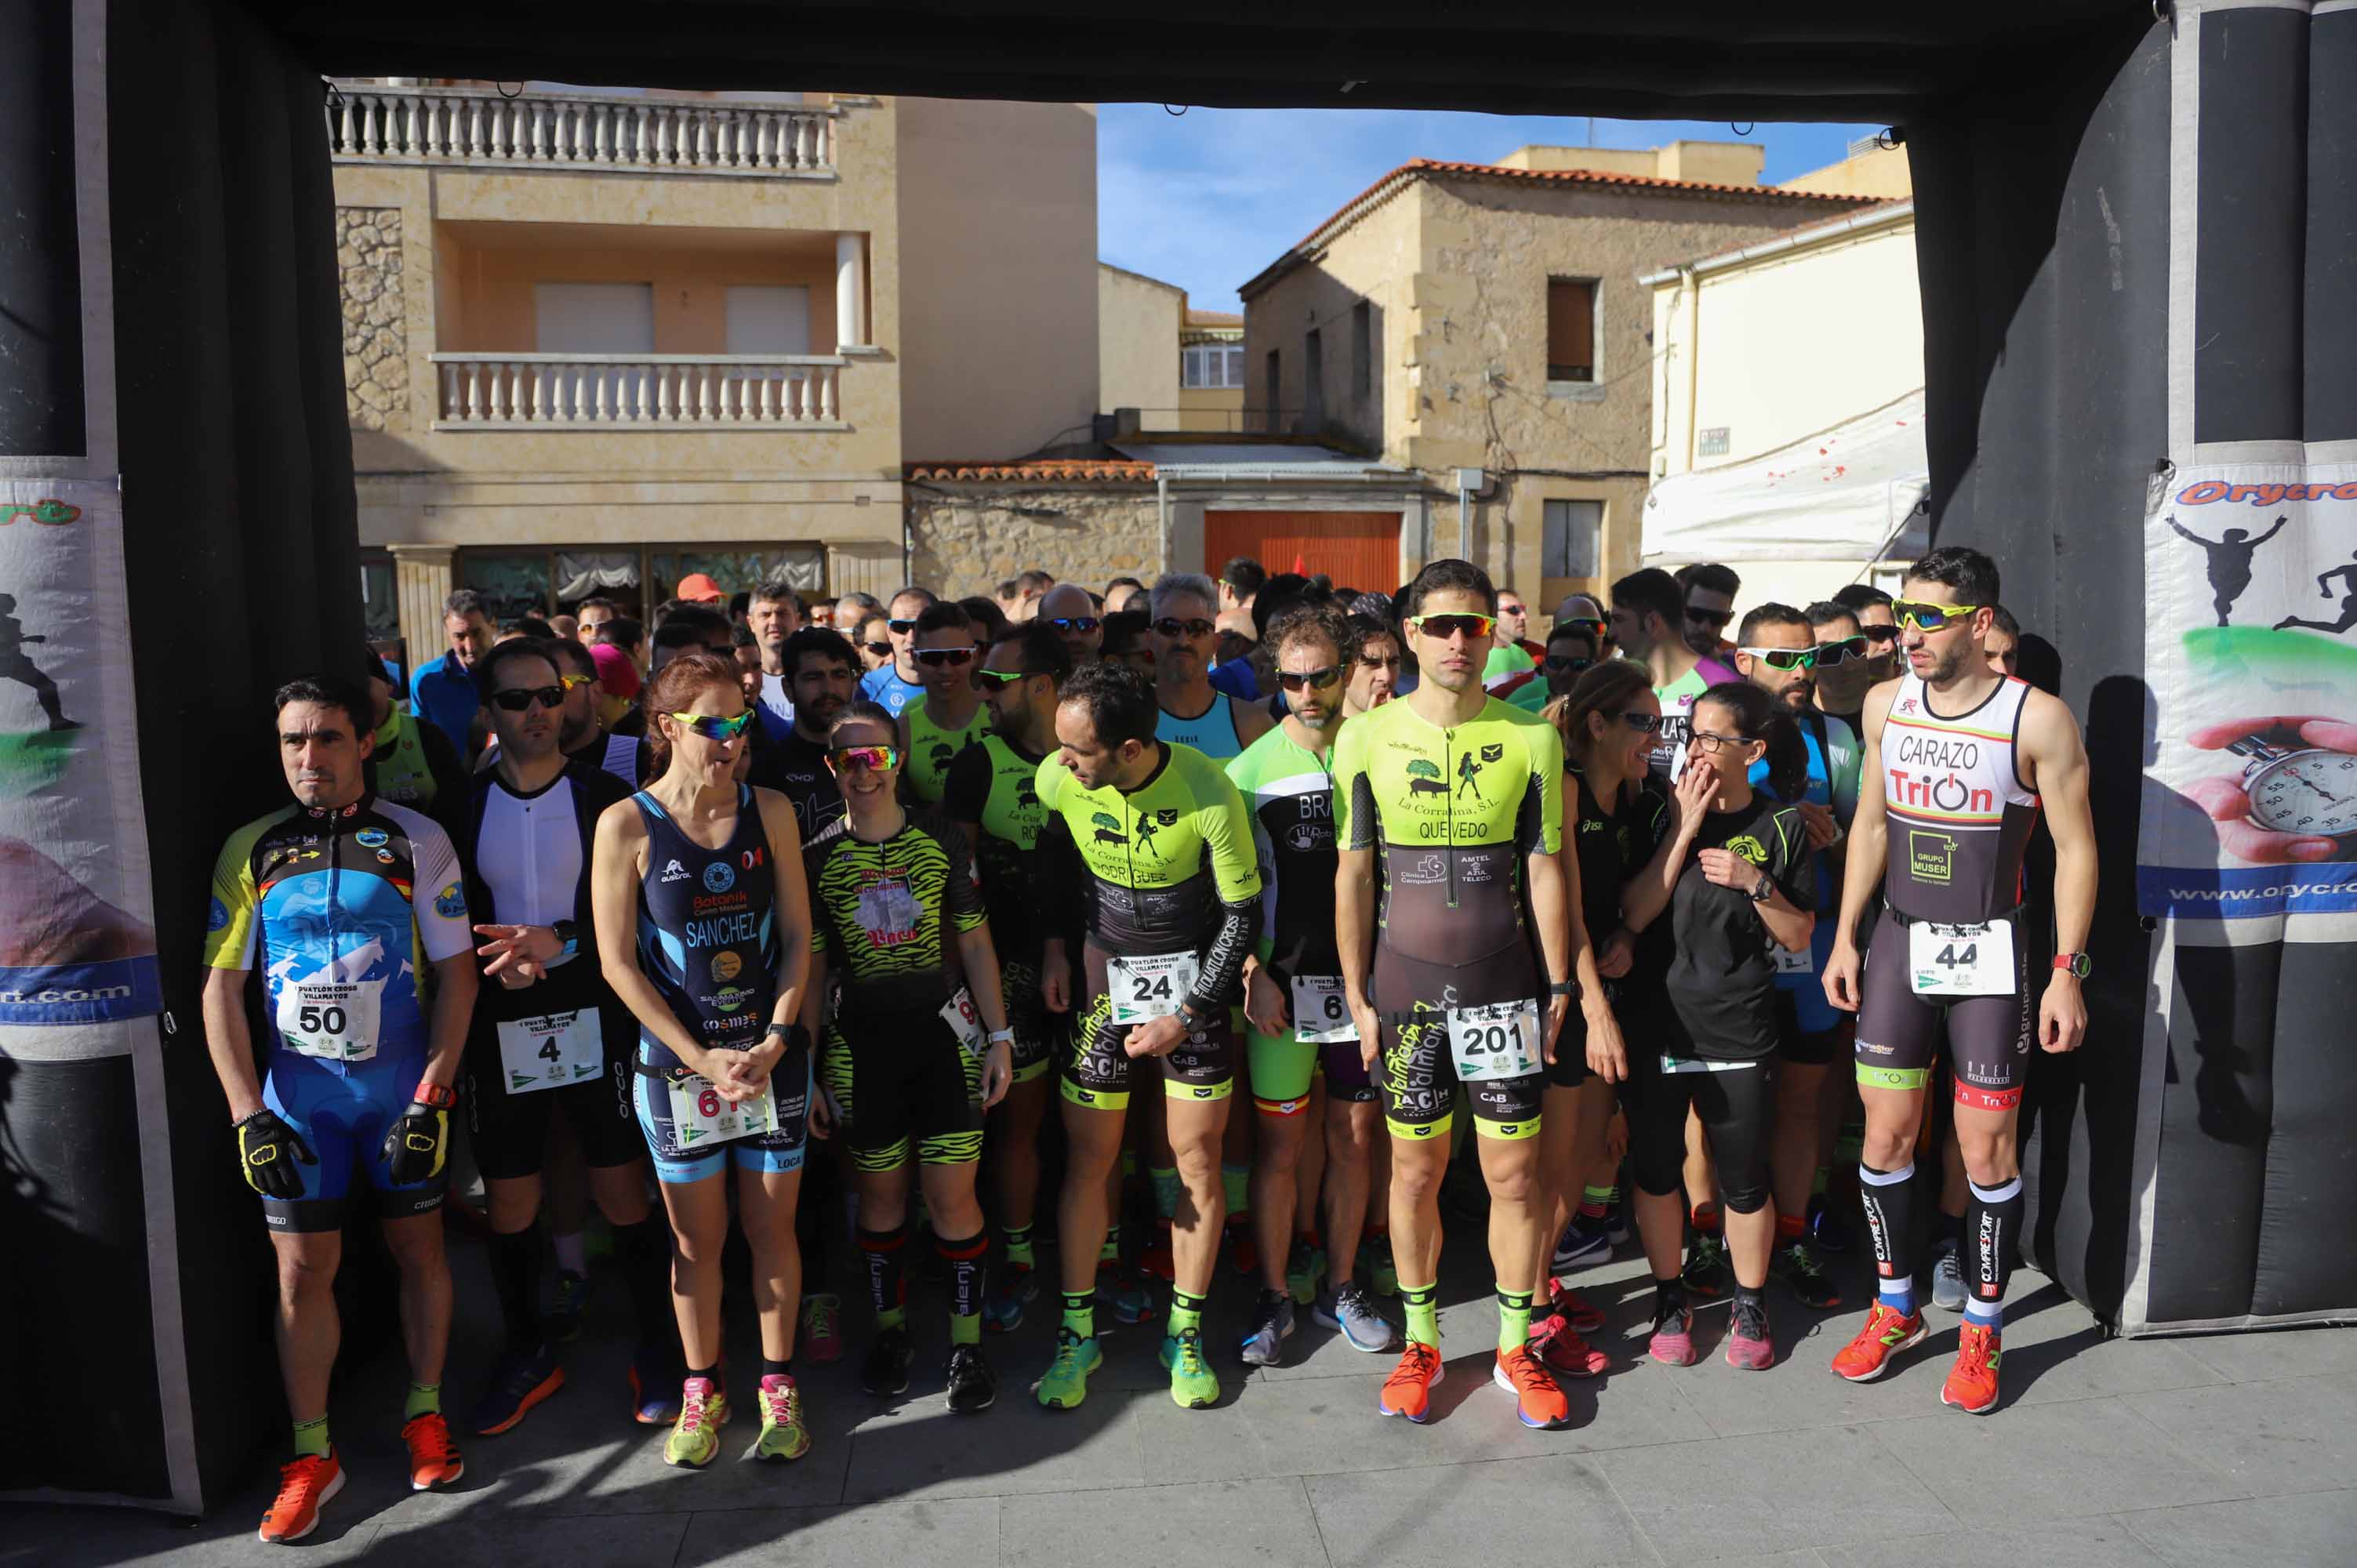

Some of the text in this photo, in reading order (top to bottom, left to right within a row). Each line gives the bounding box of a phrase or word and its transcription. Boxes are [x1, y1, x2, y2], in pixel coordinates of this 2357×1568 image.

[1900, 735, 1977, 770] CARAZO
[1398, 797, 1411, 810] La
[1420, 822, 1487, 839] QUEVEDO
[1914, 861, 1947, 874] MUSER
[1918, 853, 1944, 863] GRUPO
[686, 912, 758, 948] SANCHEZ
[1935, 943, 1977, 970] 44
[1132, 975, 1173, 1001] 24
[300, 1006, 347, 1035] 50
[538, 1036, 561, 1062] 4
[1463, 1022, 1523, 1056] 201
